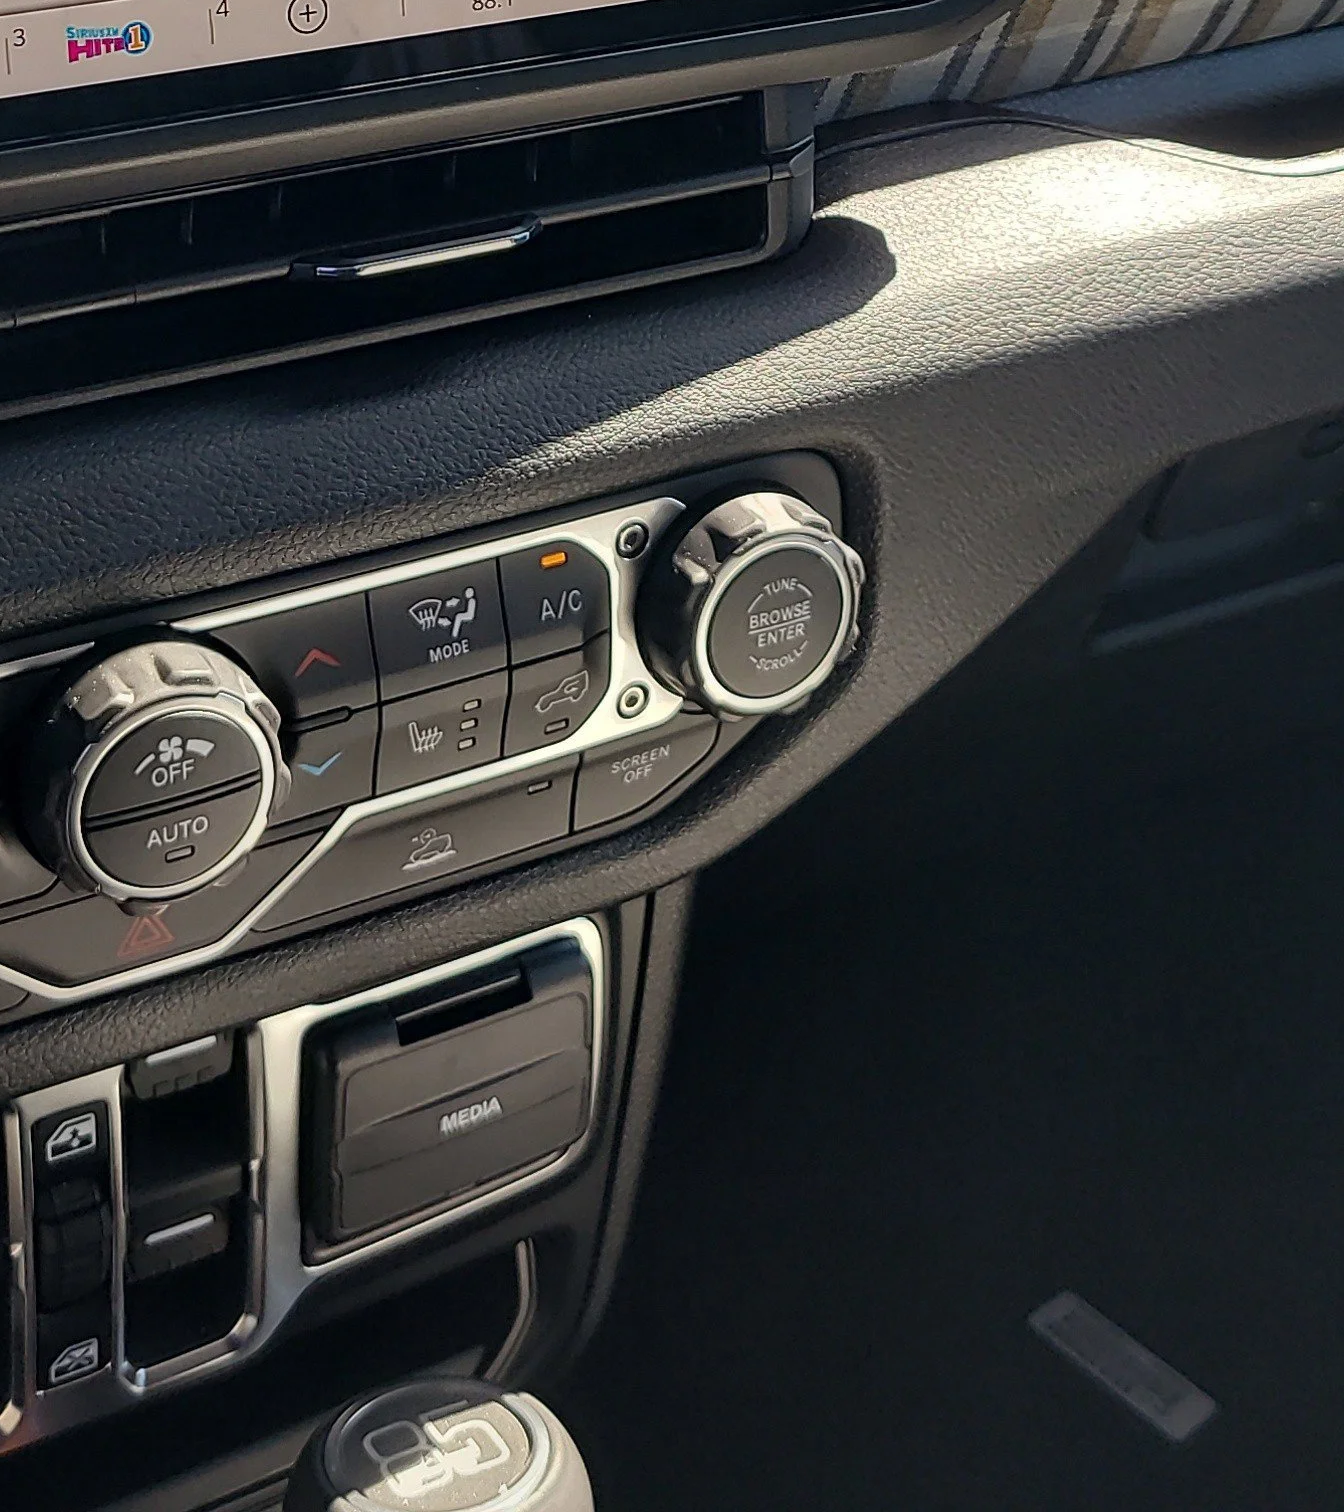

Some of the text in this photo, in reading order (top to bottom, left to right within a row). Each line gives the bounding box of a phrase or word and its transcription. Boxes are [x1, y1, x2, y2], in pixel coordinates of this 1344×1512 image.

[215, 0, 230, 18] 4
[12, 28, 26, 48] 3
[763, 576, 799, 597] TUNE
[540, 589, 583, 622] A/C
[749, 600, 812, 629] BROWSE
[756, 622, 806, 648] ENTER
[429, 638, 471, 663] MODE
[754, 650, 804, 672] SCROLL
[611, 743, 672, 774] SCREEN
[150, 758, 196, 788] OFF
[623, 762, 654, 785] OFF
[147, 816, 209, 849] AUTO
[439, 1095, 503, 1136] MEDIA
